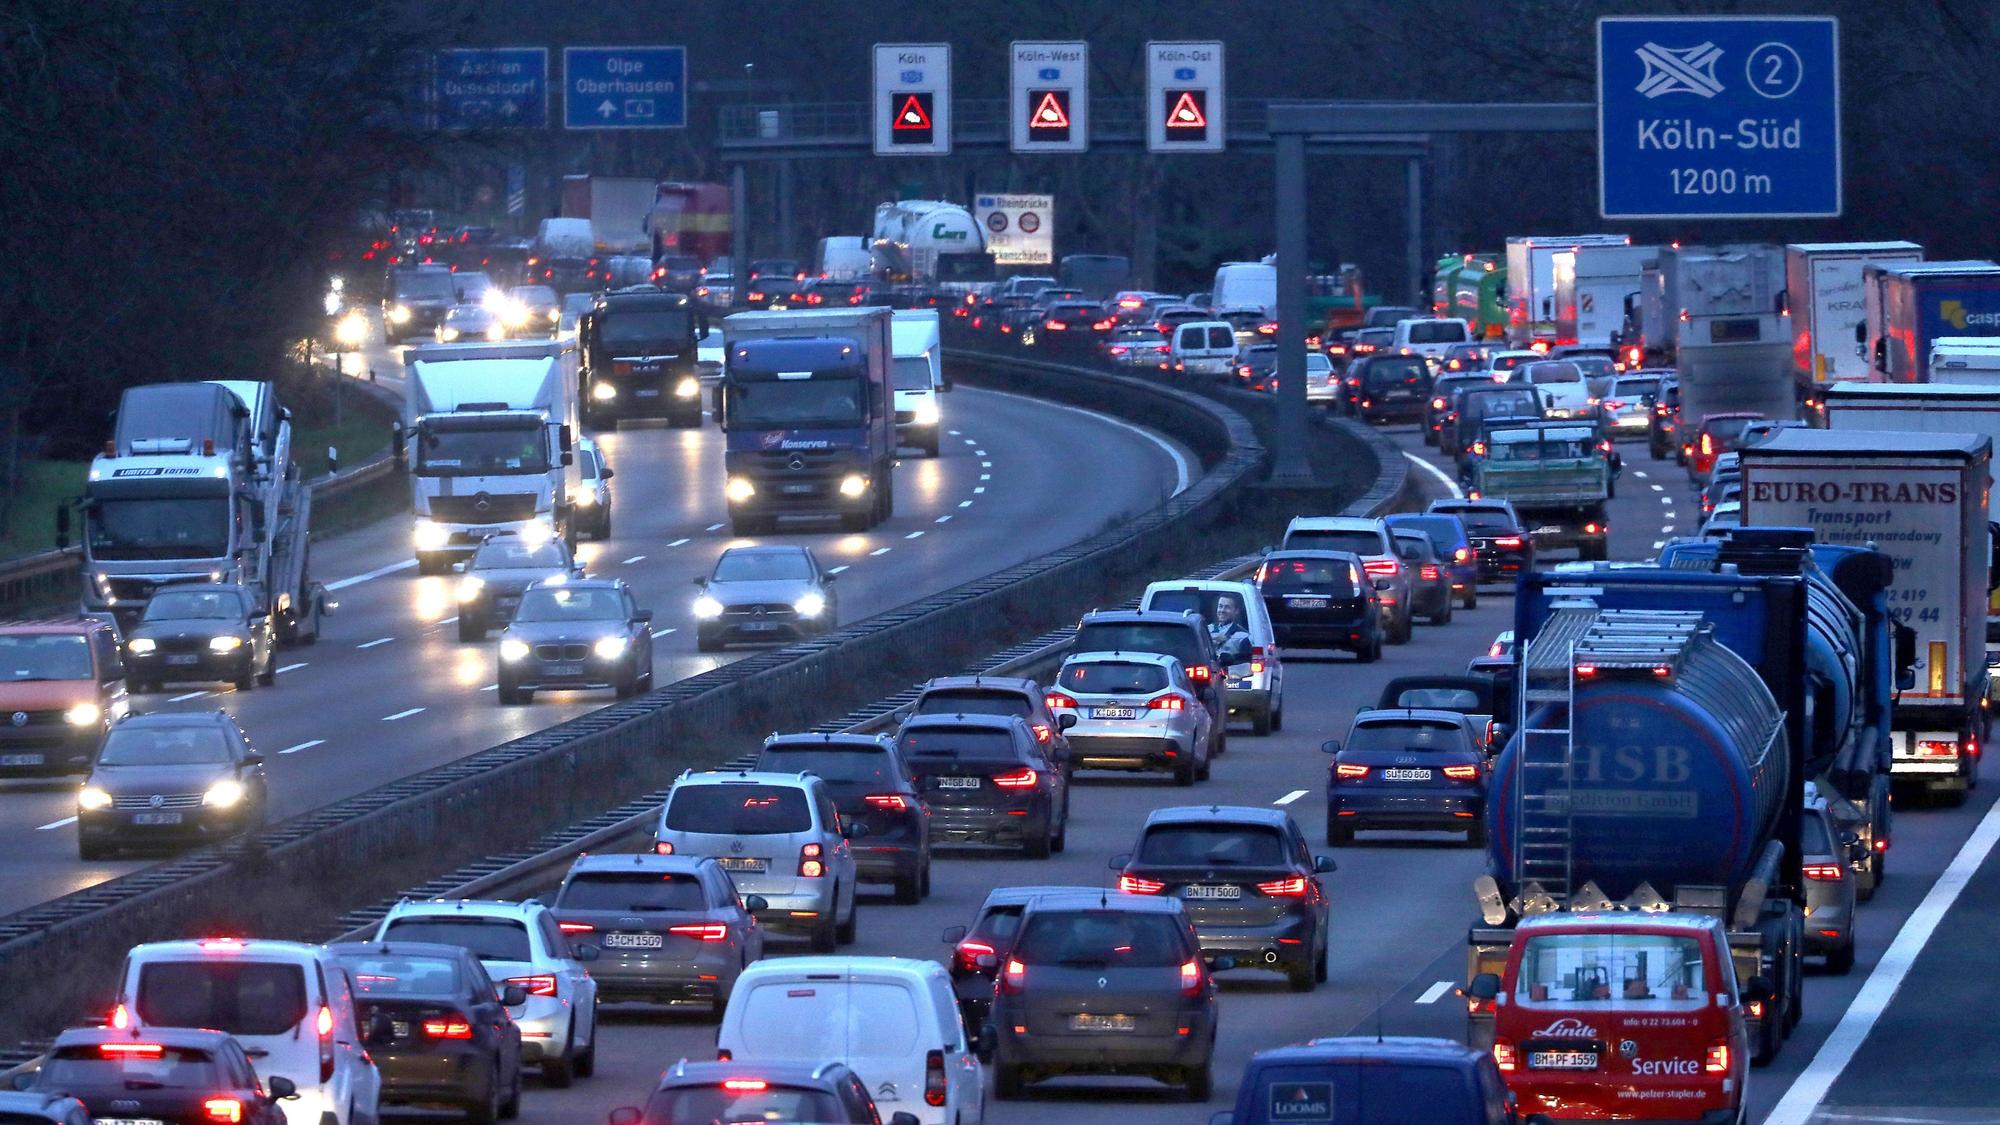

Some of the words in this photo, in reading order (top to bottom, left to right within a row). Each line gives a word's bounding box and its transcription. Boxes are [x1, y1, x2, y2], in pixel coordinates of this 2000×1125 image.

[899, 53, 925, 65] Köln
[1017, 51, 1081, 63] Köln-West
[1158, 51, 1212, 63] Köln-Ost
[607, 58, 643, 76] Olpe
[1764, 54, 1783, 85] 2
[576, 78, 674, 94] Oberhausen
[1638, 118, 1801, 150] Köln-Süd
[1670, 168, 1736, 194] 1200
[1744, 174, 1771, 194] m
[997, 197, 1048, 209] Rheinbrücke
[781, 440, 828, 449] Konserven
[120, 468, 157, 476] LIMITED
[1752, 481, 1957, 504] EURO-TRANS
[1807, 508, 1892, 525] Transport
[1829, 530, 1942, 545] międzynarodowy
[1901, 590, 1927, 601] 419
[1918, 607, 1940, 623] 44
[1119, 709, 1132, 717] 190
[1558, 745, 1692, 783] HSB
[1187, 887, 1199, 897] BN
[1205, 887, 1216, 897] IT
[1217, 888, 1239, 897] 5000
[607, 935, 614, 945] B
[620, 936, 634, 945] CH
[635, 936, 661, 946] 1509
[1532, 1018, 1597, 1037] Linde
[1624, 1018, 1639, 1027] Info:
[1650, 1018, 1660, 1026] 22
[1535, 1053, 1549, 1066] BM
[1555, 1053, 1569, 1066] PF
[1571, 1054, 1597, 1066] 1559
[1632, 1057, 1699, 1075] Service
[1617, 1089, 1707, 1099] www.pelzer-stapler.de
[1275, 1103, 1326, 1114] LOOMIS
